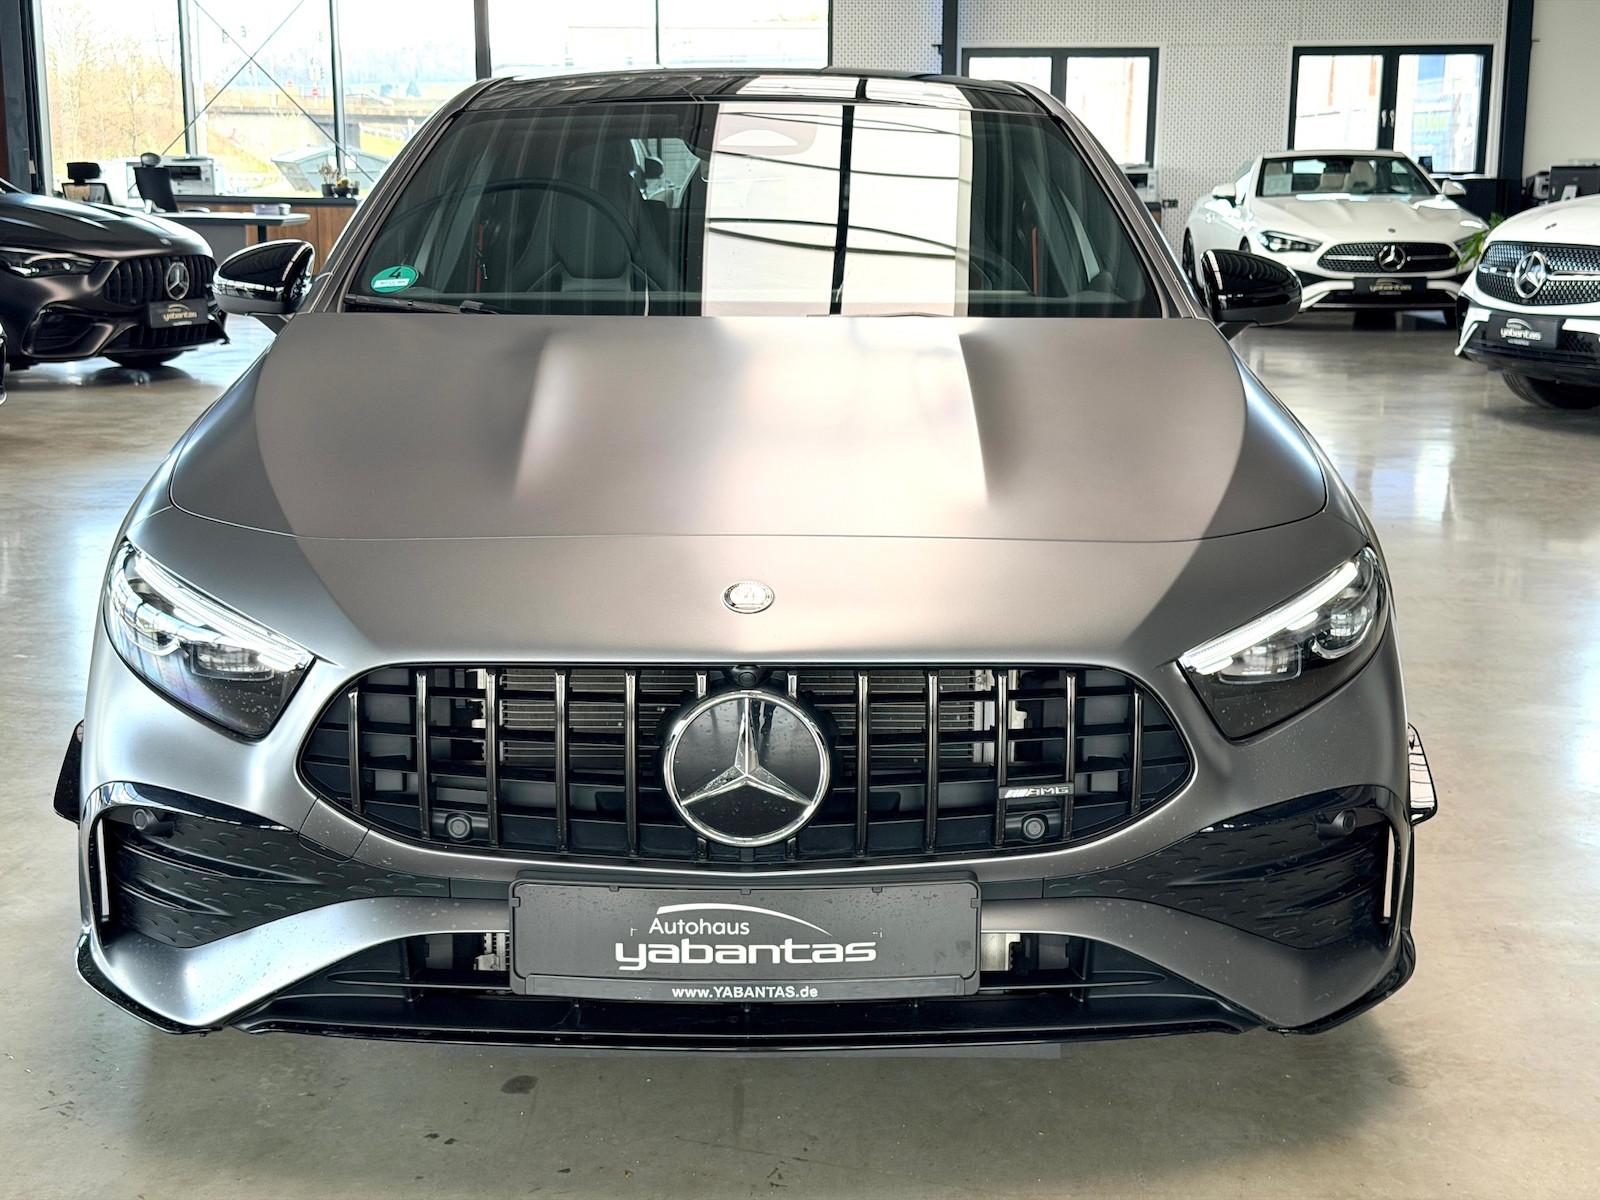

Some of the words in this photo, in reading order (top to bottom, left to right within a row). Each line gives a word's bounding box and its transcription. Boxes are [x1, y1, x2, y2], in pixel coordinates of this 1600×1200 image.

[388, 267, 401, 279] 4
[1025, 786, 1069, 797] AMG
[648, 918, 750, 936] Autohaus
[615, 938, 877, 971] yabantas
[672, 985, 819, 1000] www.YABANTAS.de
